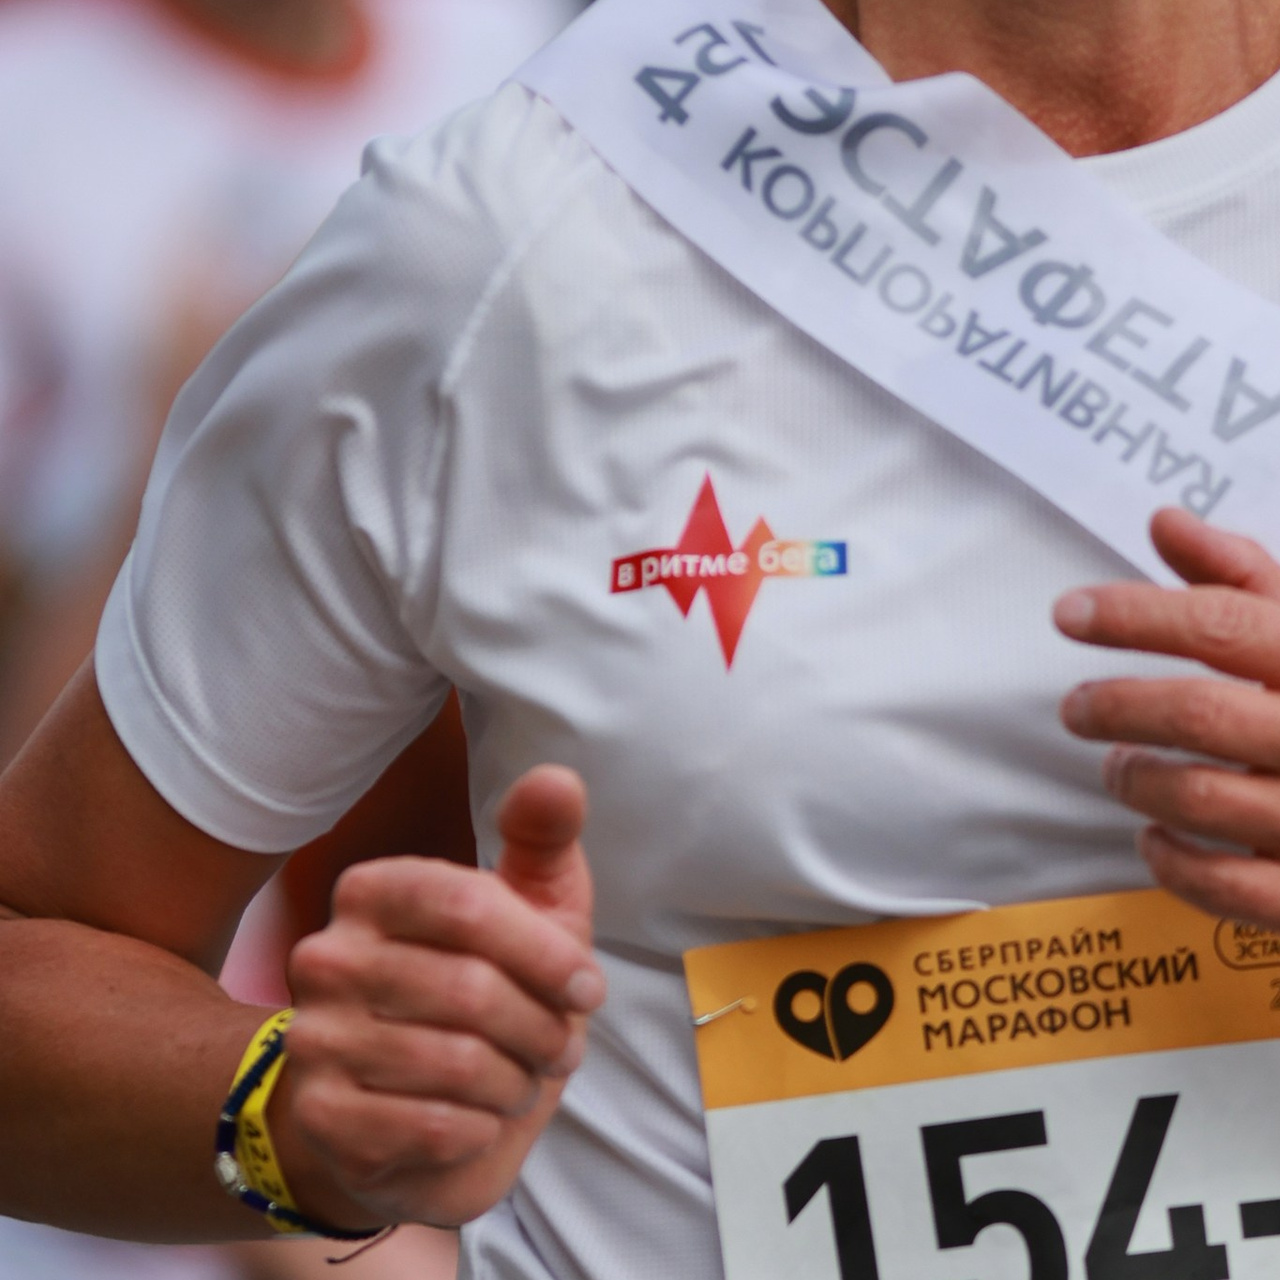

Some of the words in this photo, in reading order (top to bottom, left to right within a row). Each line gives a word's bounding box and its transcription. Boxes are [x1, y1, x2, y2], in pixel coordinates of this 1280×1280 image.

[617, 563, 636, 588] в
[641, 550, 750, 588] ритме
[914, 927, 1123, 976] СБЕРПРАЙМ
[917, 946, 1200, 1015] МОСКОВСКИЙ
[923, 996, 1132, 1052] МАРАФОН
